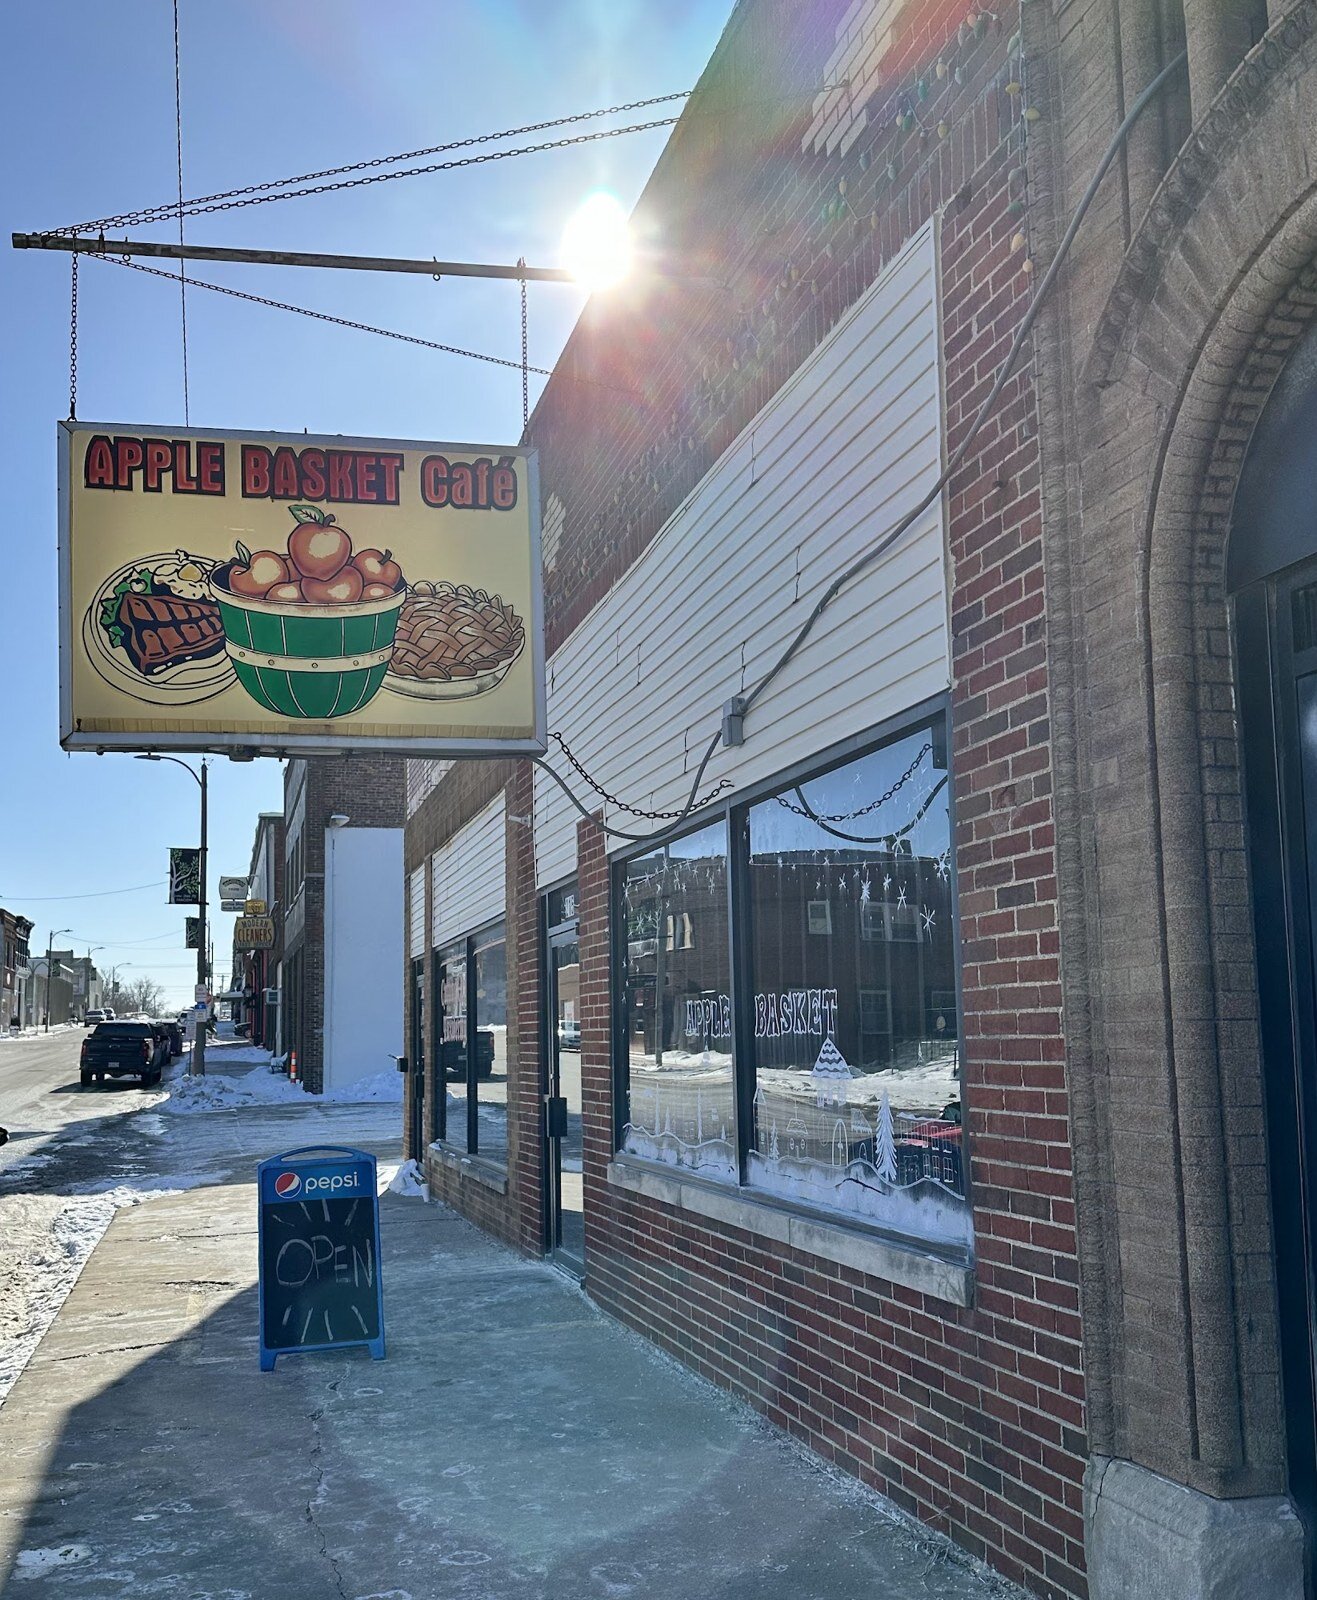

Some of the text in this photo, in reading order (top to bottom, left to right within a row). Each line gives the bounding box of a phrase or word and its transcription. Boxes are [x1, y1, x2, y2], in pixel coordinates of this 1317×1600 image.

[85, 436, 517, 510] APPLE BASKET Café
[237, 928, 273, 943] CLEANERS
[241, 919, 269, 928] MODERN
[685, 988, 838, 1038] APPLE BASKET
[305, 1171, 360, 1194] pepsi
[276, 1235, 373, 1288] OPEN
